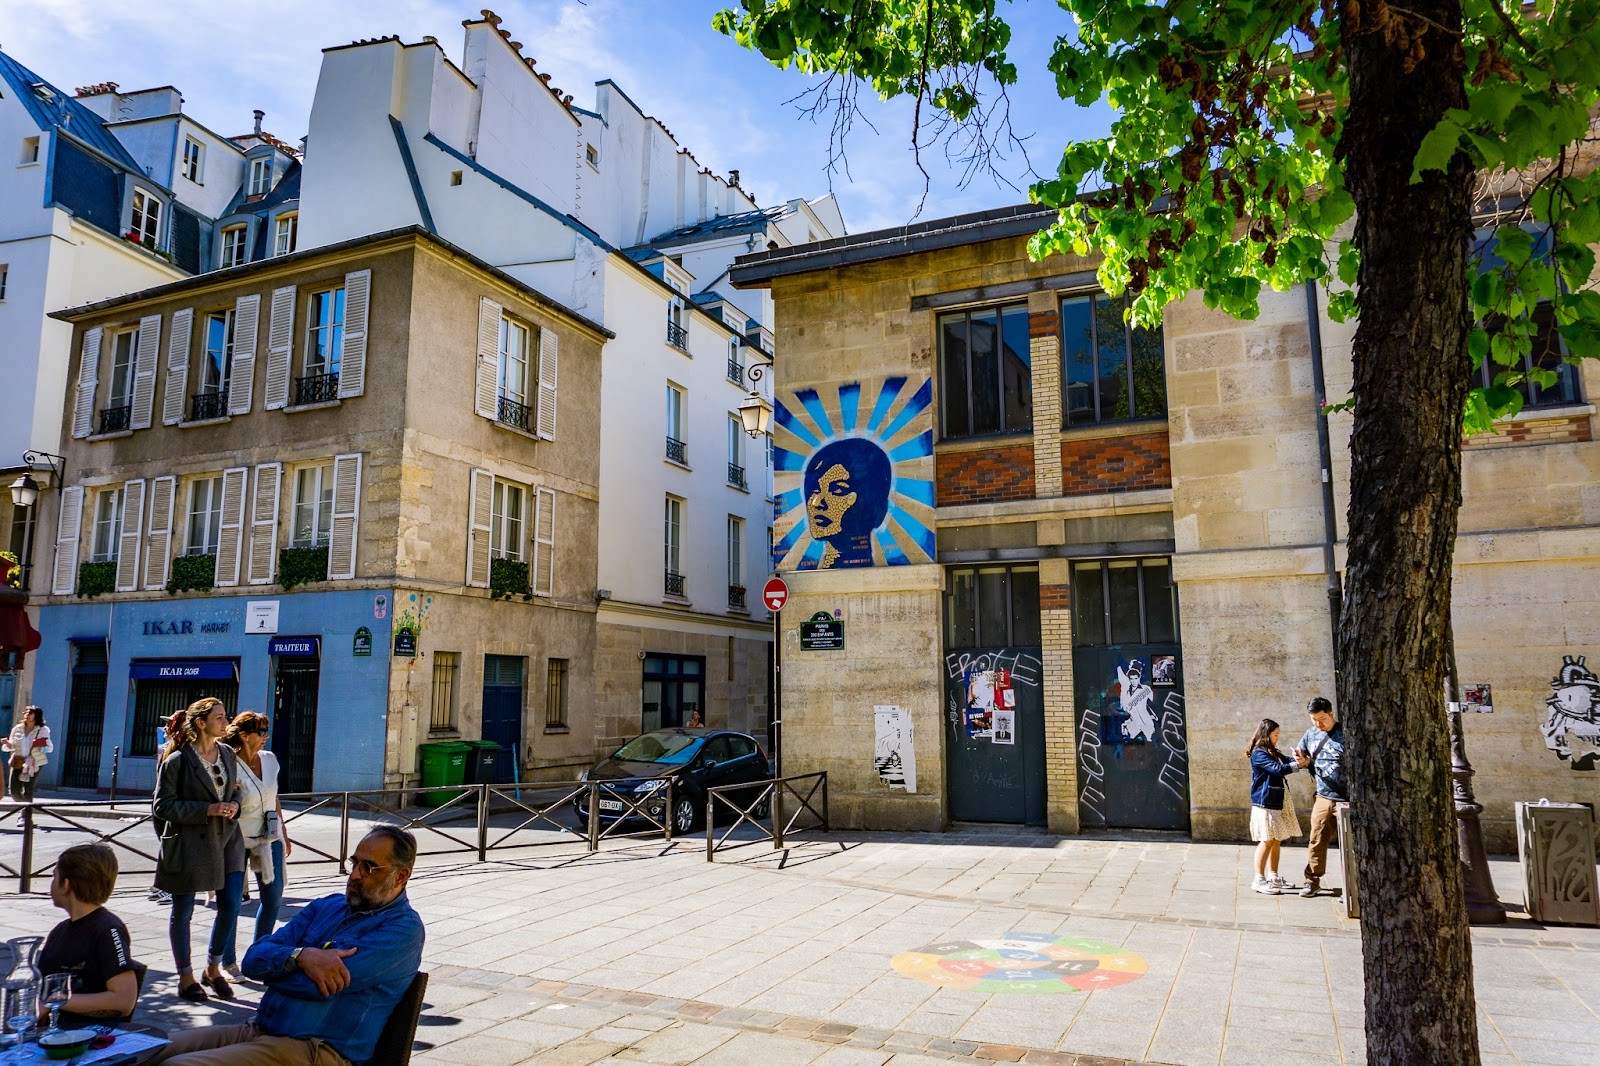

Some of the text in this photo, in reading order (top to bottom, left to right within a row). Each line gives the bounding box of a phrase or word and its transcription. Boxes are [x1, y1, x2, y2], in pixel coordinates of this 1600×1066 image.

[142, 620, 231, 636] IKAR MARKET
[274, 643, 310, 652] TRAITEUR
[159, 667, 182, 676] IKAR
[110, 928, 127, 966] ADVENTURE
